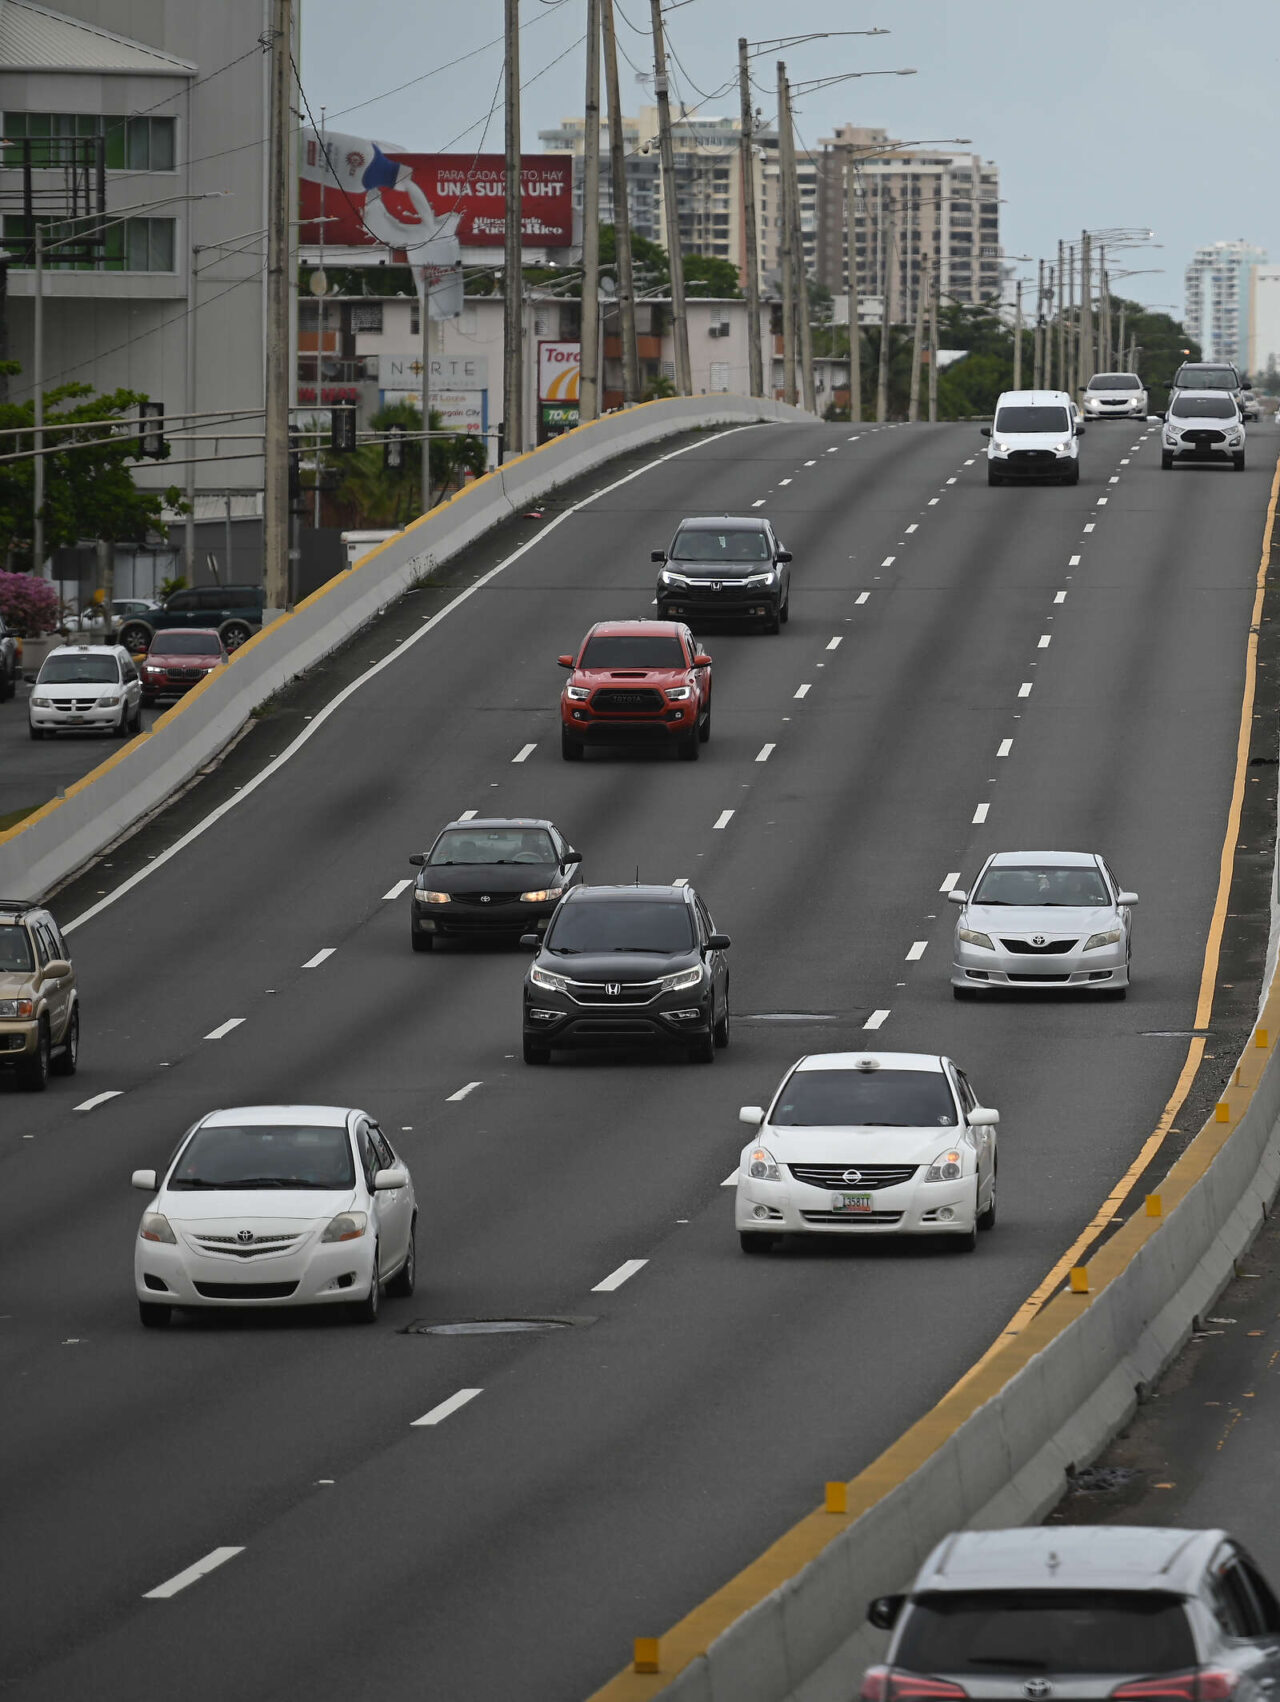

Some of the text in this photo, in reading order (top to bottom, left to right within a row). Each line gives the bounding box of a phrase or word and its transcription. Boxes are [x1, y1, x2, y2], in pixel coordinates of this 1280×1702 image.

[437, 170, 465, 180] PARA
[467, 170, 497, 180] CADA
[542, 170, 563, 180] HAY
[437, 182, 472, 196] UNA
[528, 182, 564, 196] UHT
